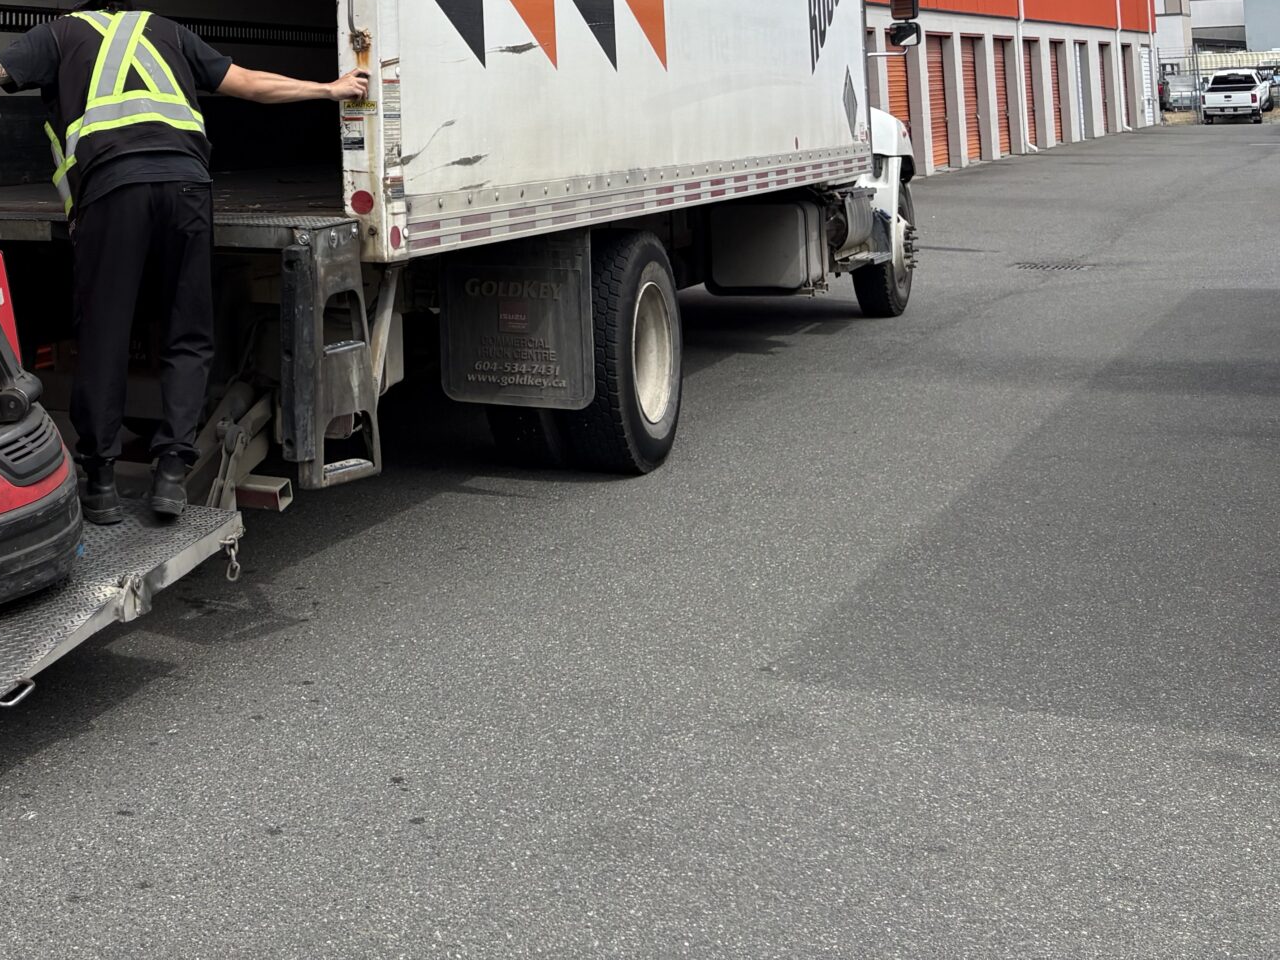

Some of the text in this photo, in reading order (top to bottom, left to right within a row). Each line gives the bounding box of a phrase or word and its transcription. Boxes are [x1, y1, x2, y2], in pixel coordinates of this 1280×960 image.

[499, 313, 526, 321] ISUZU
[513, 349, 557, 361] CENTRE
[474, 361, 560, 376] 604-534-7431
[467, 373, 567, 388] www.goldkey.ca
